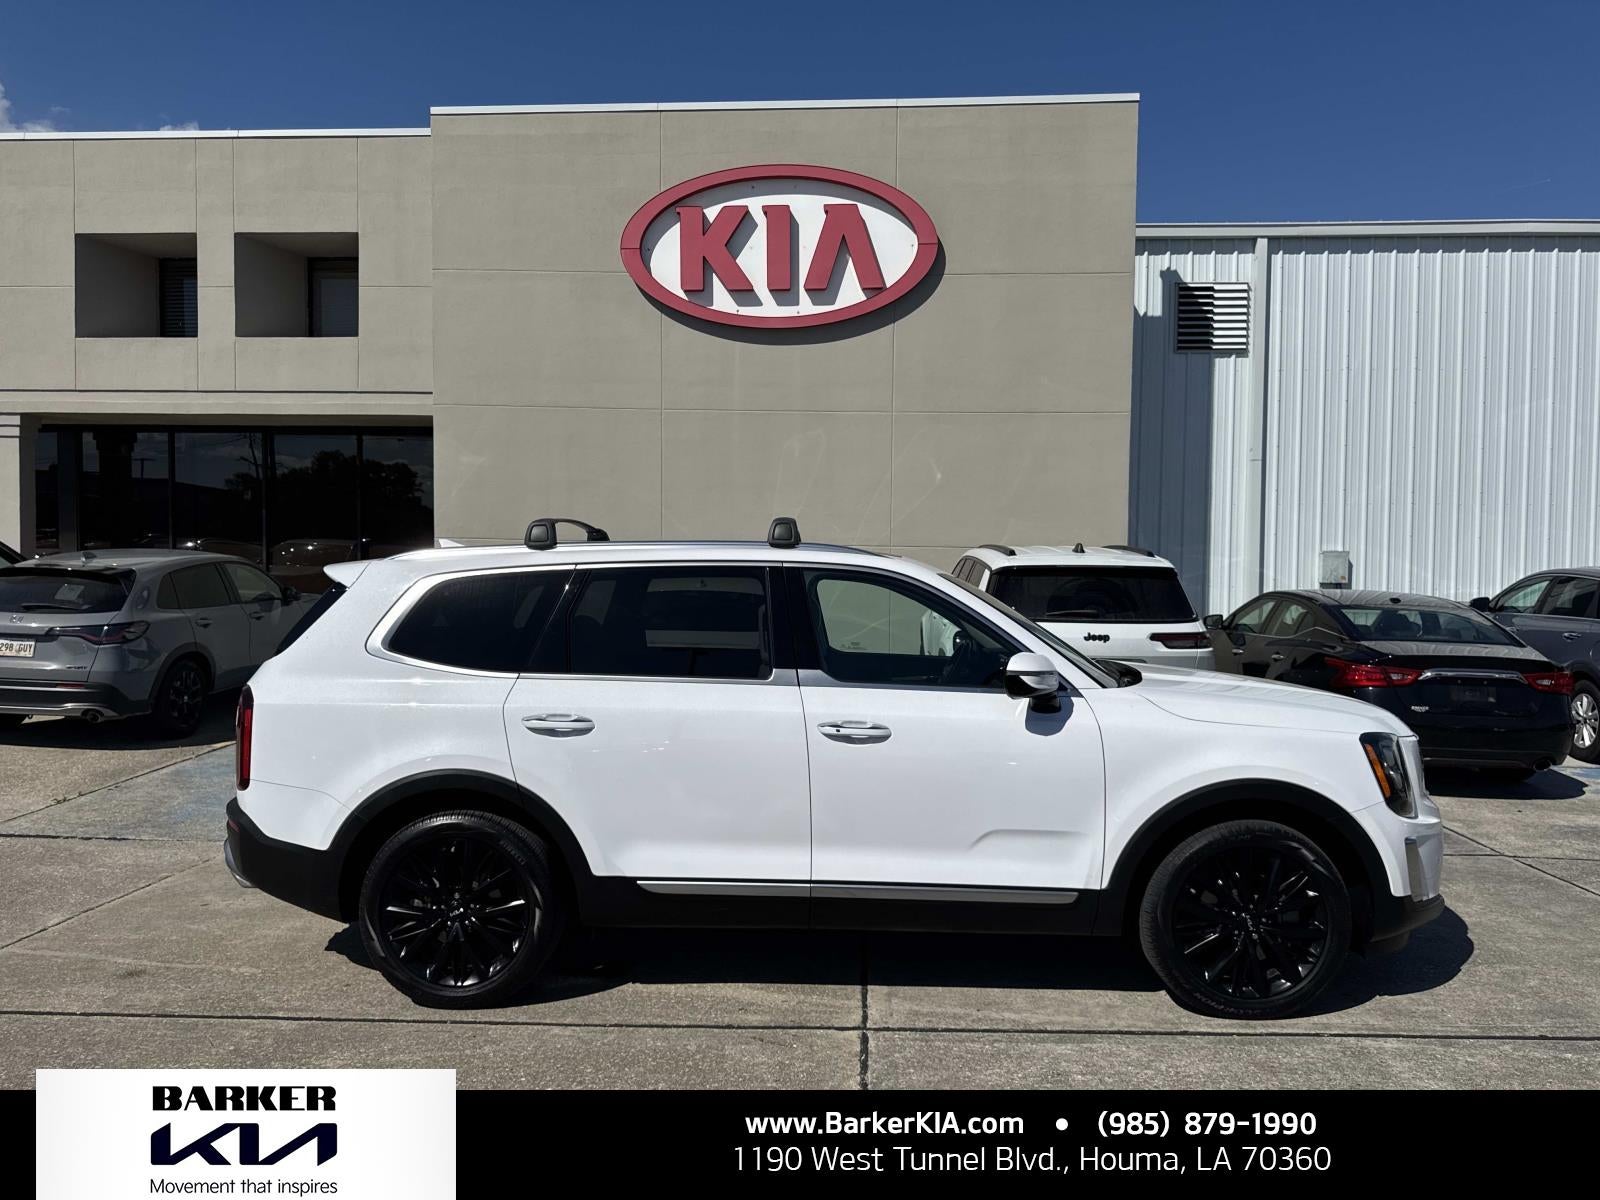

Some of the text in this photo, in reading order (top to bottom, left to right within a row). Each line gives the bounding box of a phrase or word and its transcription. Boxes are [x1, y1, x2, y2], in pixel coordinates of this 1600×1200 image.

[675, 203, 887, 291] KIA
[1083, 631, 1111, 643] Jeep
[18, 643, 33, 653] GUY
